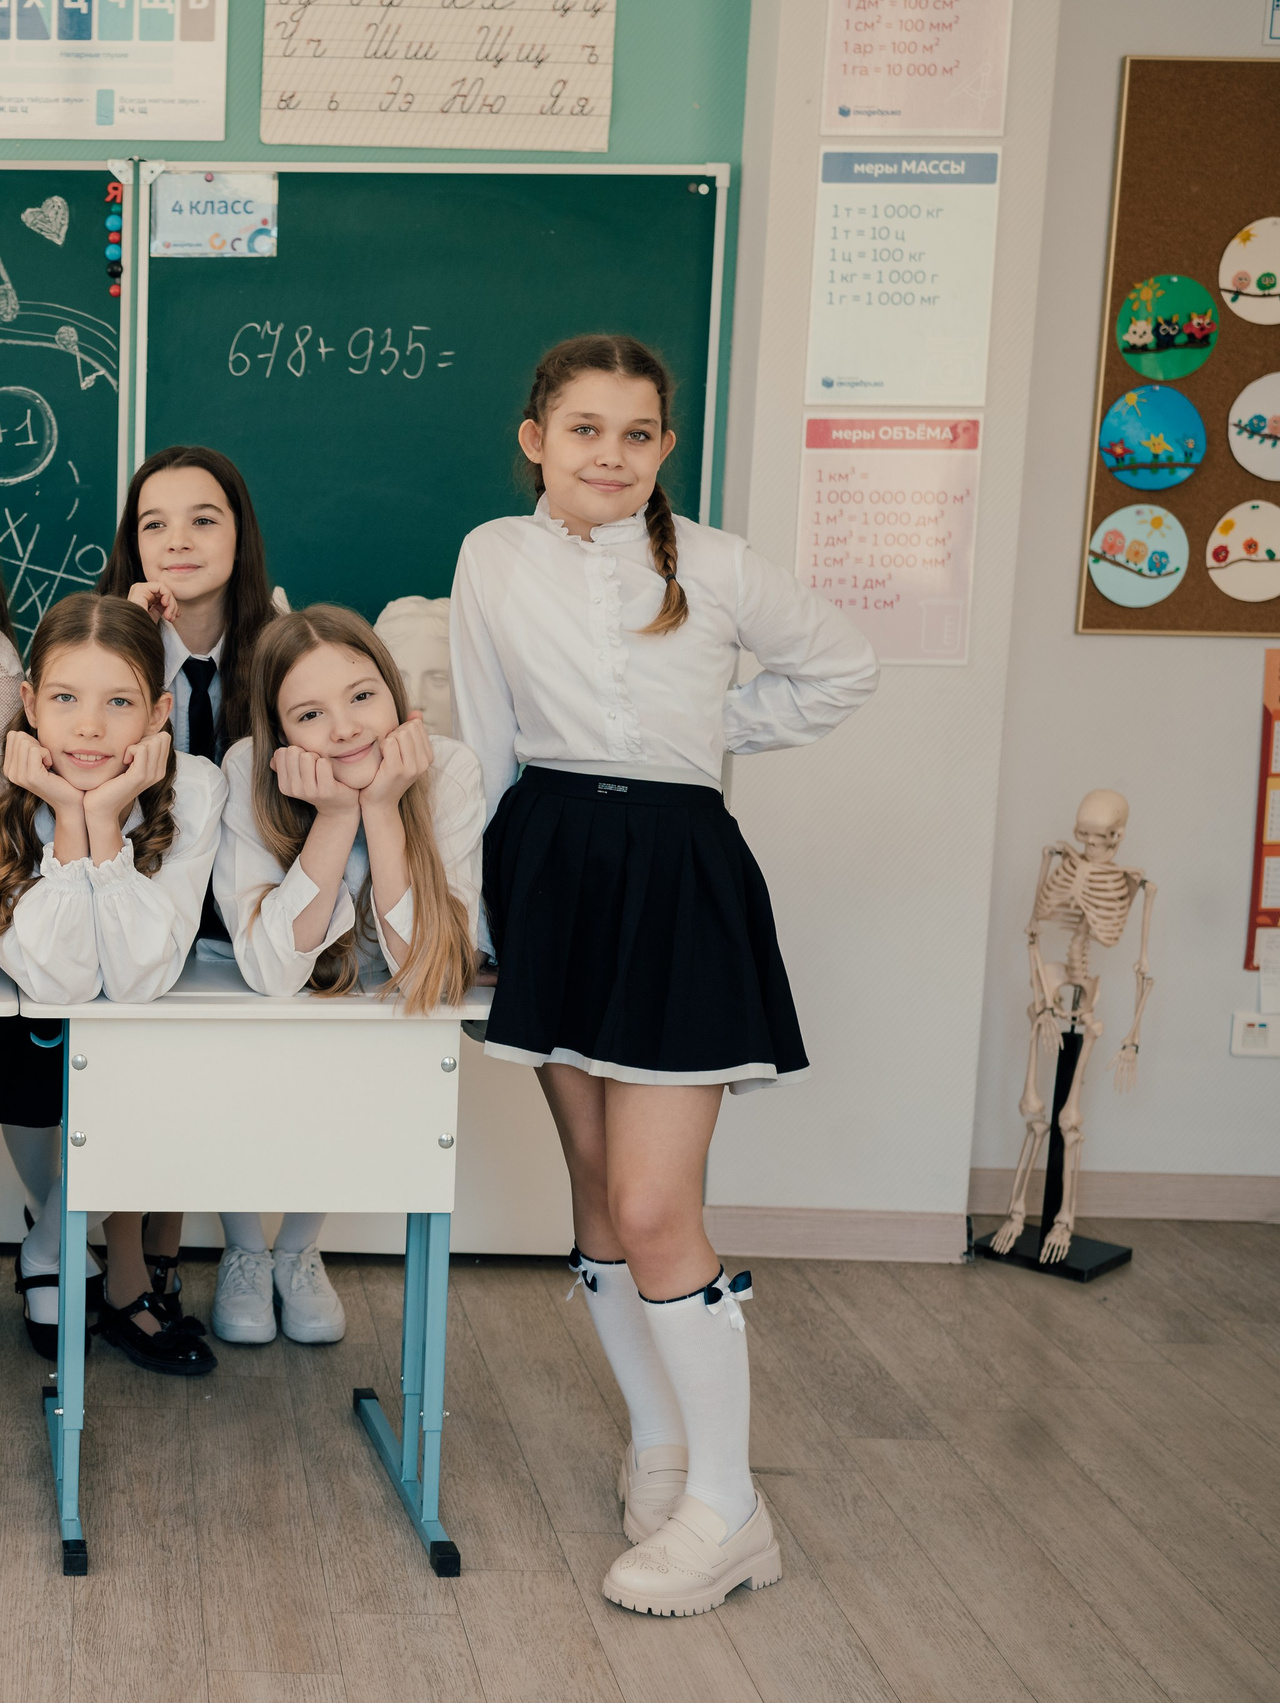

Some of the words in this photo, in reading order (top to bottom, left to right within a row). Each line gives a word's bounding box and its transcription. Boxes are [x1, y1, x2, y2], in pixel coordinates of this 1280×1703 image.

[845, 20, 850, 31] 1
[854, 15, 881, 32] см²
[899, 20, 924, 32] 100
[929, 15, 960, 32] мм²
[844, 42, 848, 54] 1
[853, 44, 874, 56] ар
[892, 42, 918, 54] 100
[922, 38, 940, 54] м²
[854, 164, 898, 176] меры
[902, 160, 965, 174] МАССЫ
[172, 200, 184, 215] 4
[190, 200, 254, 214] класс
[832, 206, 839, 218] 1
[844, 209, 853, 218] т
[872, 206, 878, 218] 1
[884, 206, 921, 218] 000
[926, 208, 944, 218] кг
[831, 227, 838, 240] 1
[843, 230, 852, 240] т
[871, 227, 890, 240] 10
[896, 230, 906, 242] ц
[830, 249, 836, 262] 1
[842, 252, 852, 263] ц
[872, 249, 904, 262] 100
[909, 252, 926, 262] кг
[828, 271, 836, 284] 1
[841, 274, 857, 284] кг
[877, 271, 883, 284] 1
[889, 271, 925, 284] 000
[931, 274, 939, 284] г
[827, 292, 834, 305] 1
[839, 296, 846, 305] г
[866, 292, 872, 305] 1
[878, 292, 915, 306] 000
[920, 296, 940, 306] мг
[832, 429, 874, 443] меры
[879, 424, 952, 441] ОБЪЁМА
